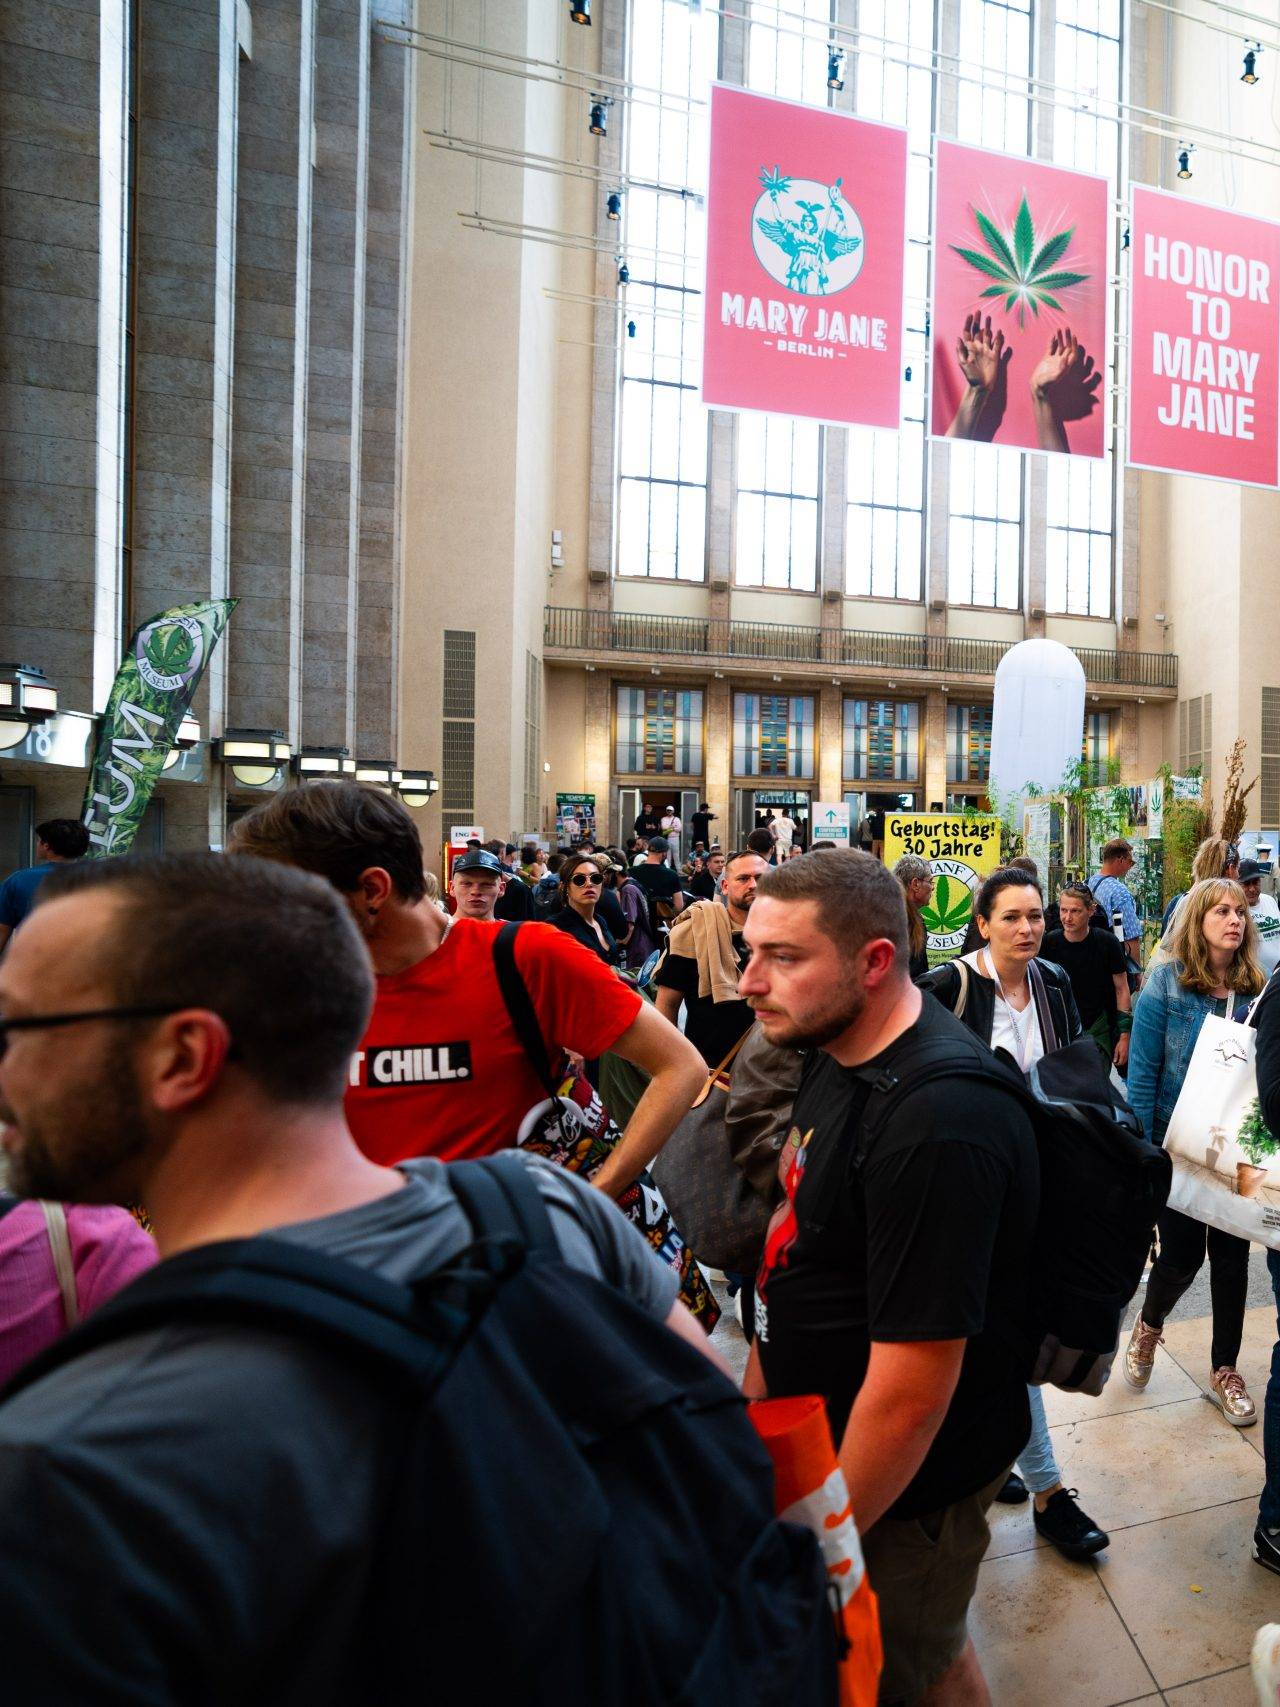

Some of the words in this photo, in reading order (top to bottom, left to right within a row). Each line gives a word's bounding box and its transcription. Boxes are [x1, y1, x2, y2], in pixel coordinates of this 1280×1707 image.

[1144, 233, 1270, 305] HONOR
[720, 291, 807, 338] MARY
[813, 309, 889, 352] JANE
[1186, 291, 1232, 341] TO
[777, 341, 834, 358] BERLIN
[1152, 332, 1260, 394] MARY
[1157, 383, 1255, 440] JANE
[140, 662, 180, 688] MUSEUM
[890, 820, 996, 840] Geburtstag!
[903, 838, 924, 857] 30
[930, 839, 983, 858] Jahre
[930, 861, 966, 876] ANF
[373, 1047, 469, 1084] CHILL.
